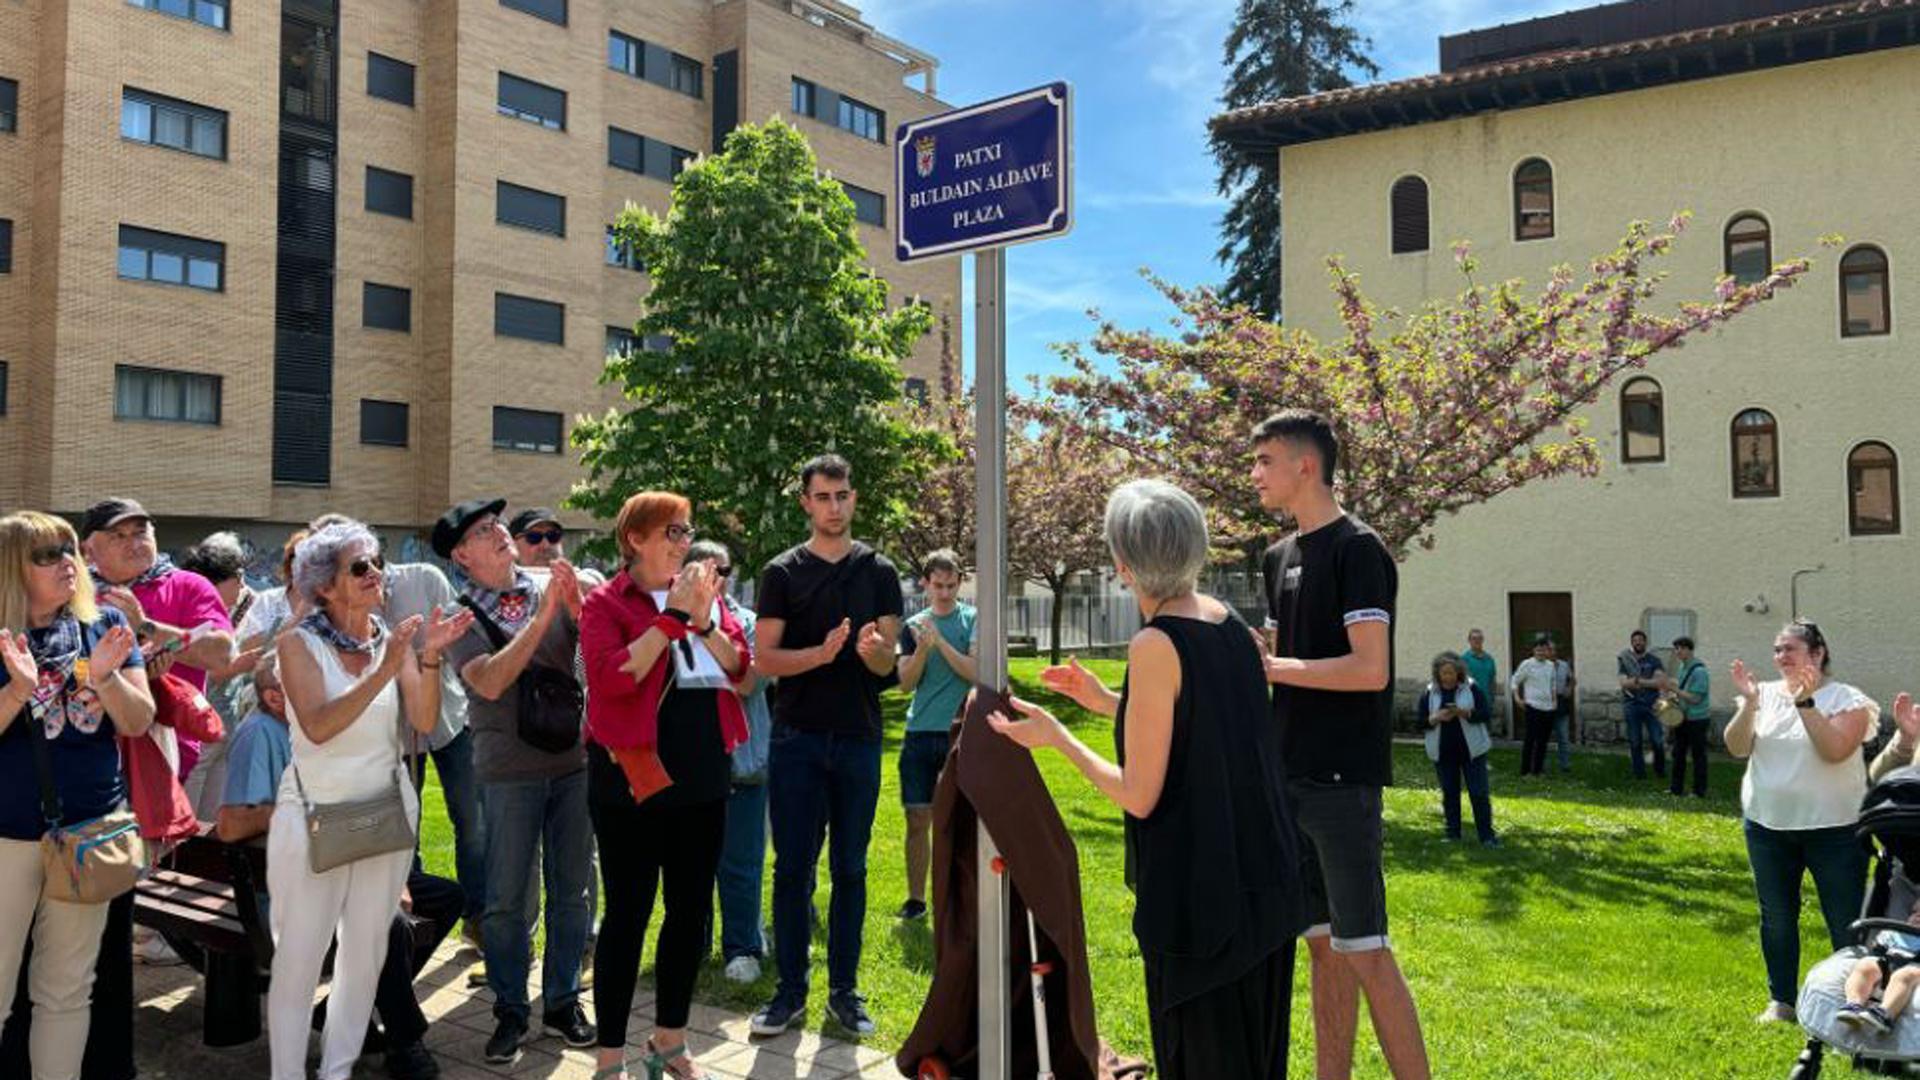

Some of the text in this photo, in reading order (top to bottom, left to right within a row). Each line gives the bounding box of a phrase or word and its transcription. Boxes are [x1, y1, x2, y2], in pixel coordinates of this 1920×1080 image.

[954, 143, 1003, 169] PATXI
[910, 162, 1053, 208] BULDAIN ALDAVE
[953, 204, 1004, 229] PLAZA
